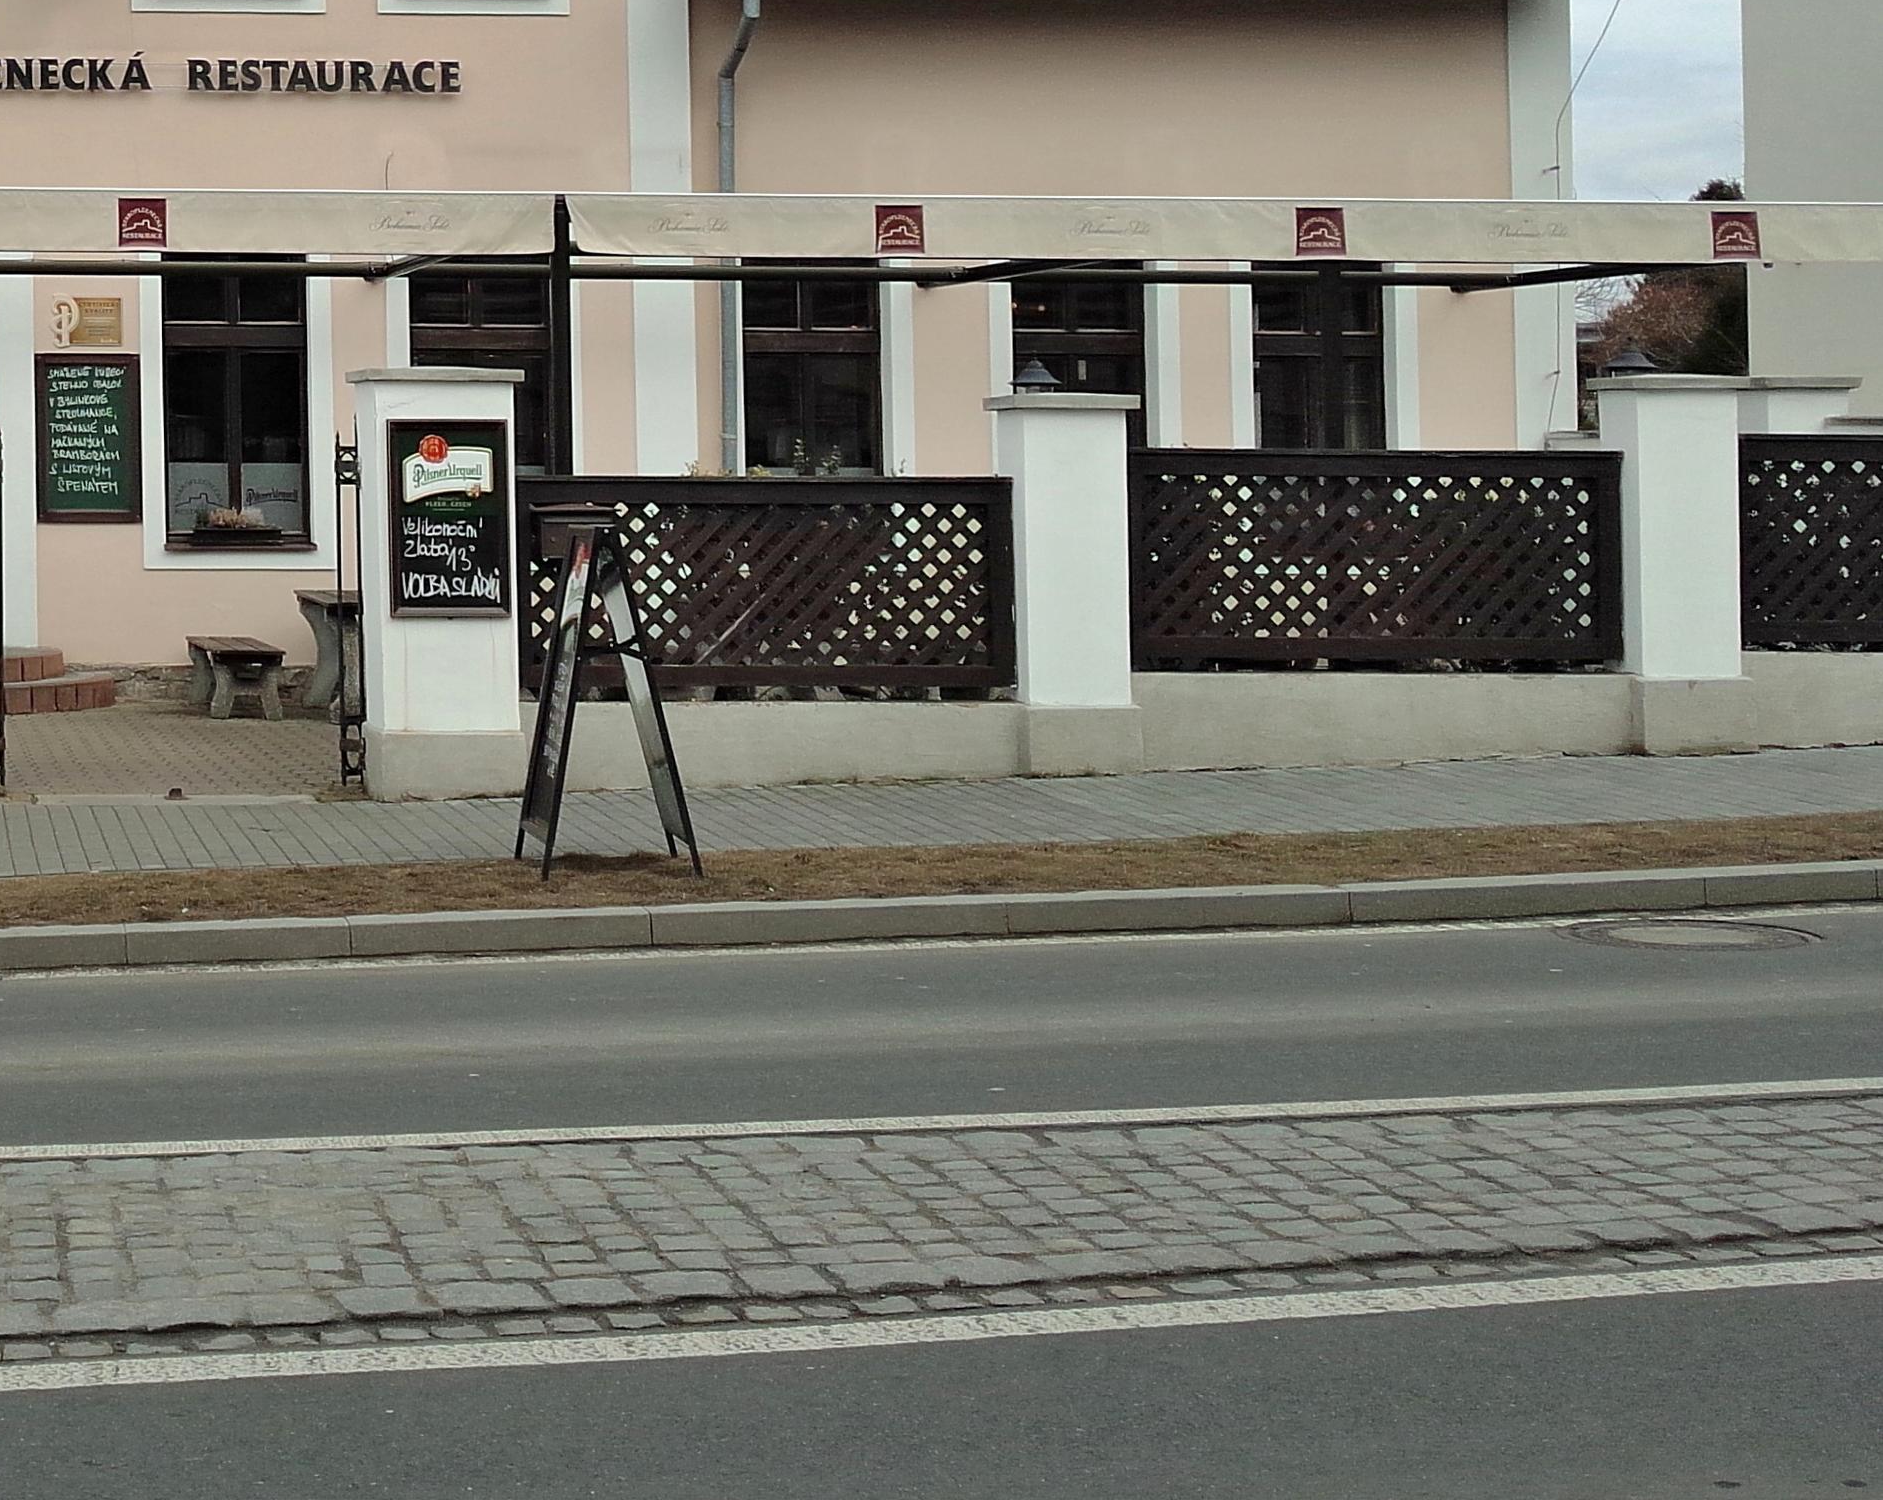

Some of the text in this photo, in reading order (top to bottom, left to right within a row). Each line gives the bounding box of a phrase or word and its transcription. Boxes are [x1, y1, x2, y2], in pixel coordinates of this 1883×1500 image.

[187, 59, 461, 93] RESTAURACE
[104, 424, 119, 436] NA
[48, 462, 58, 475] S
[413, 462, 483, 489] Pilsner Urquell
[57, 476, 119, 496] ŠPENÁTEM
[402, 516, 483, 538] Velikonoční
[404, 537, 453, 557] Zlatá
[402, 571, 451, 599] VOLBA
